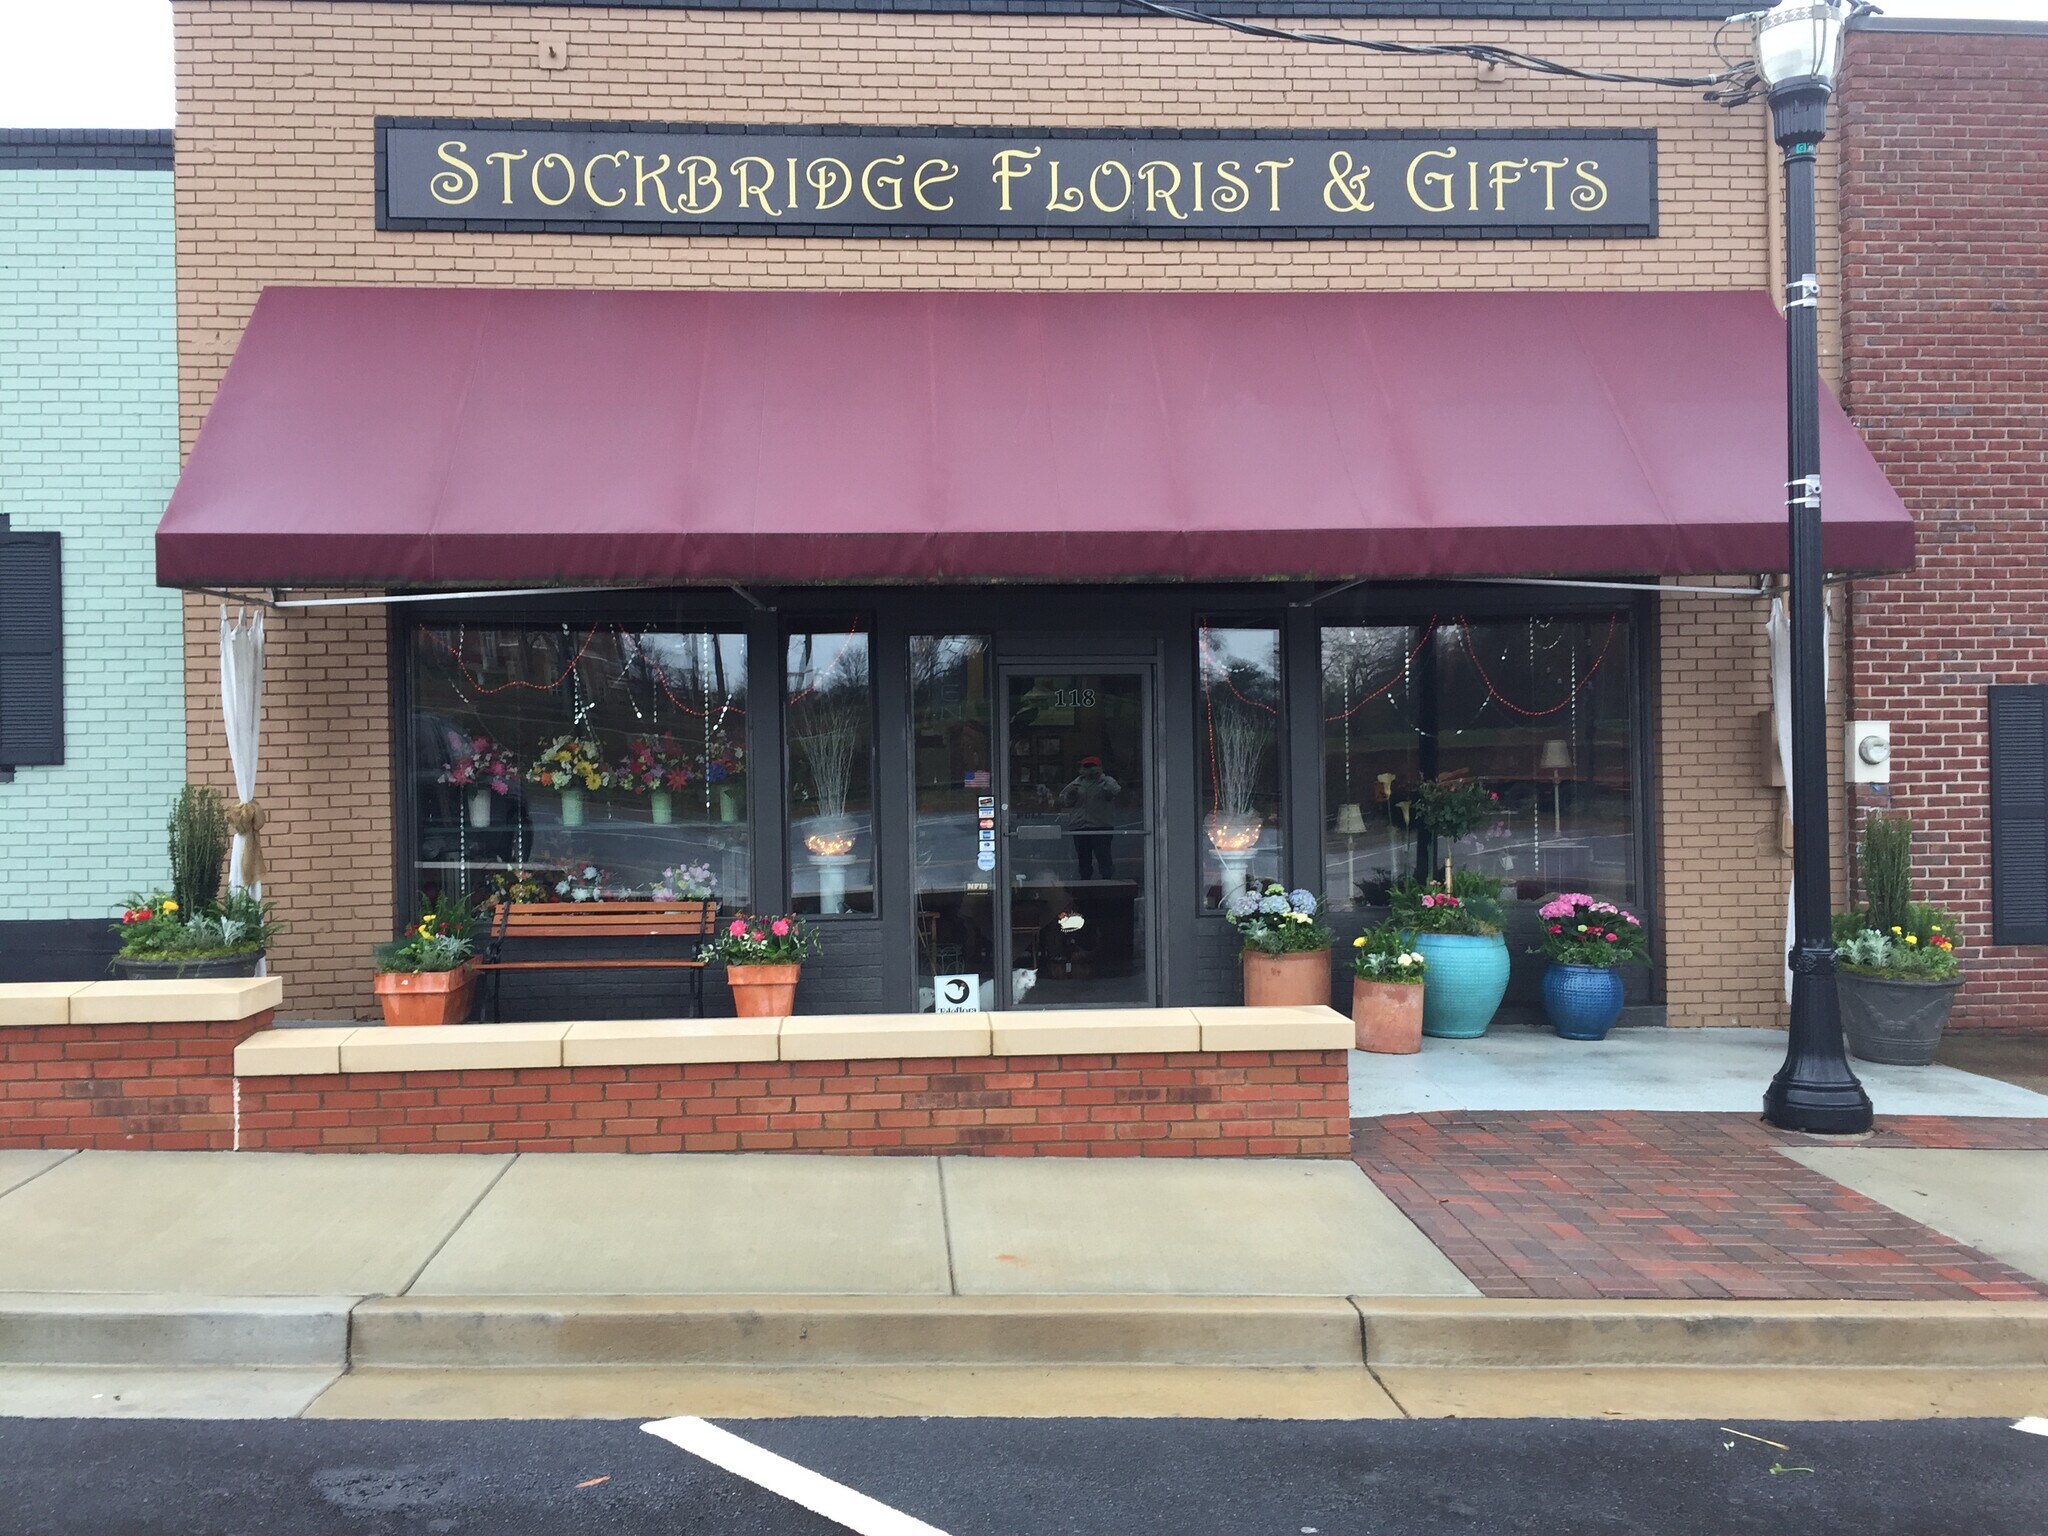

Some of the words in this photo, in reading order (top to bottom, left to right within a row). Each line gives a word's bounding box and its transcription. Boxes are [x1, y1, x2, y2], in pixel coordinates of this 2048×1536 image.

[430, 141, 958, 216] STOCKBRIDGE
[991, 145, 1294, 219] FLORIST
[1322, 150, 1375, 212] &
[1405, 145, 1609, 212] GIFTS
[1054, 688, 1096, 708] 118
